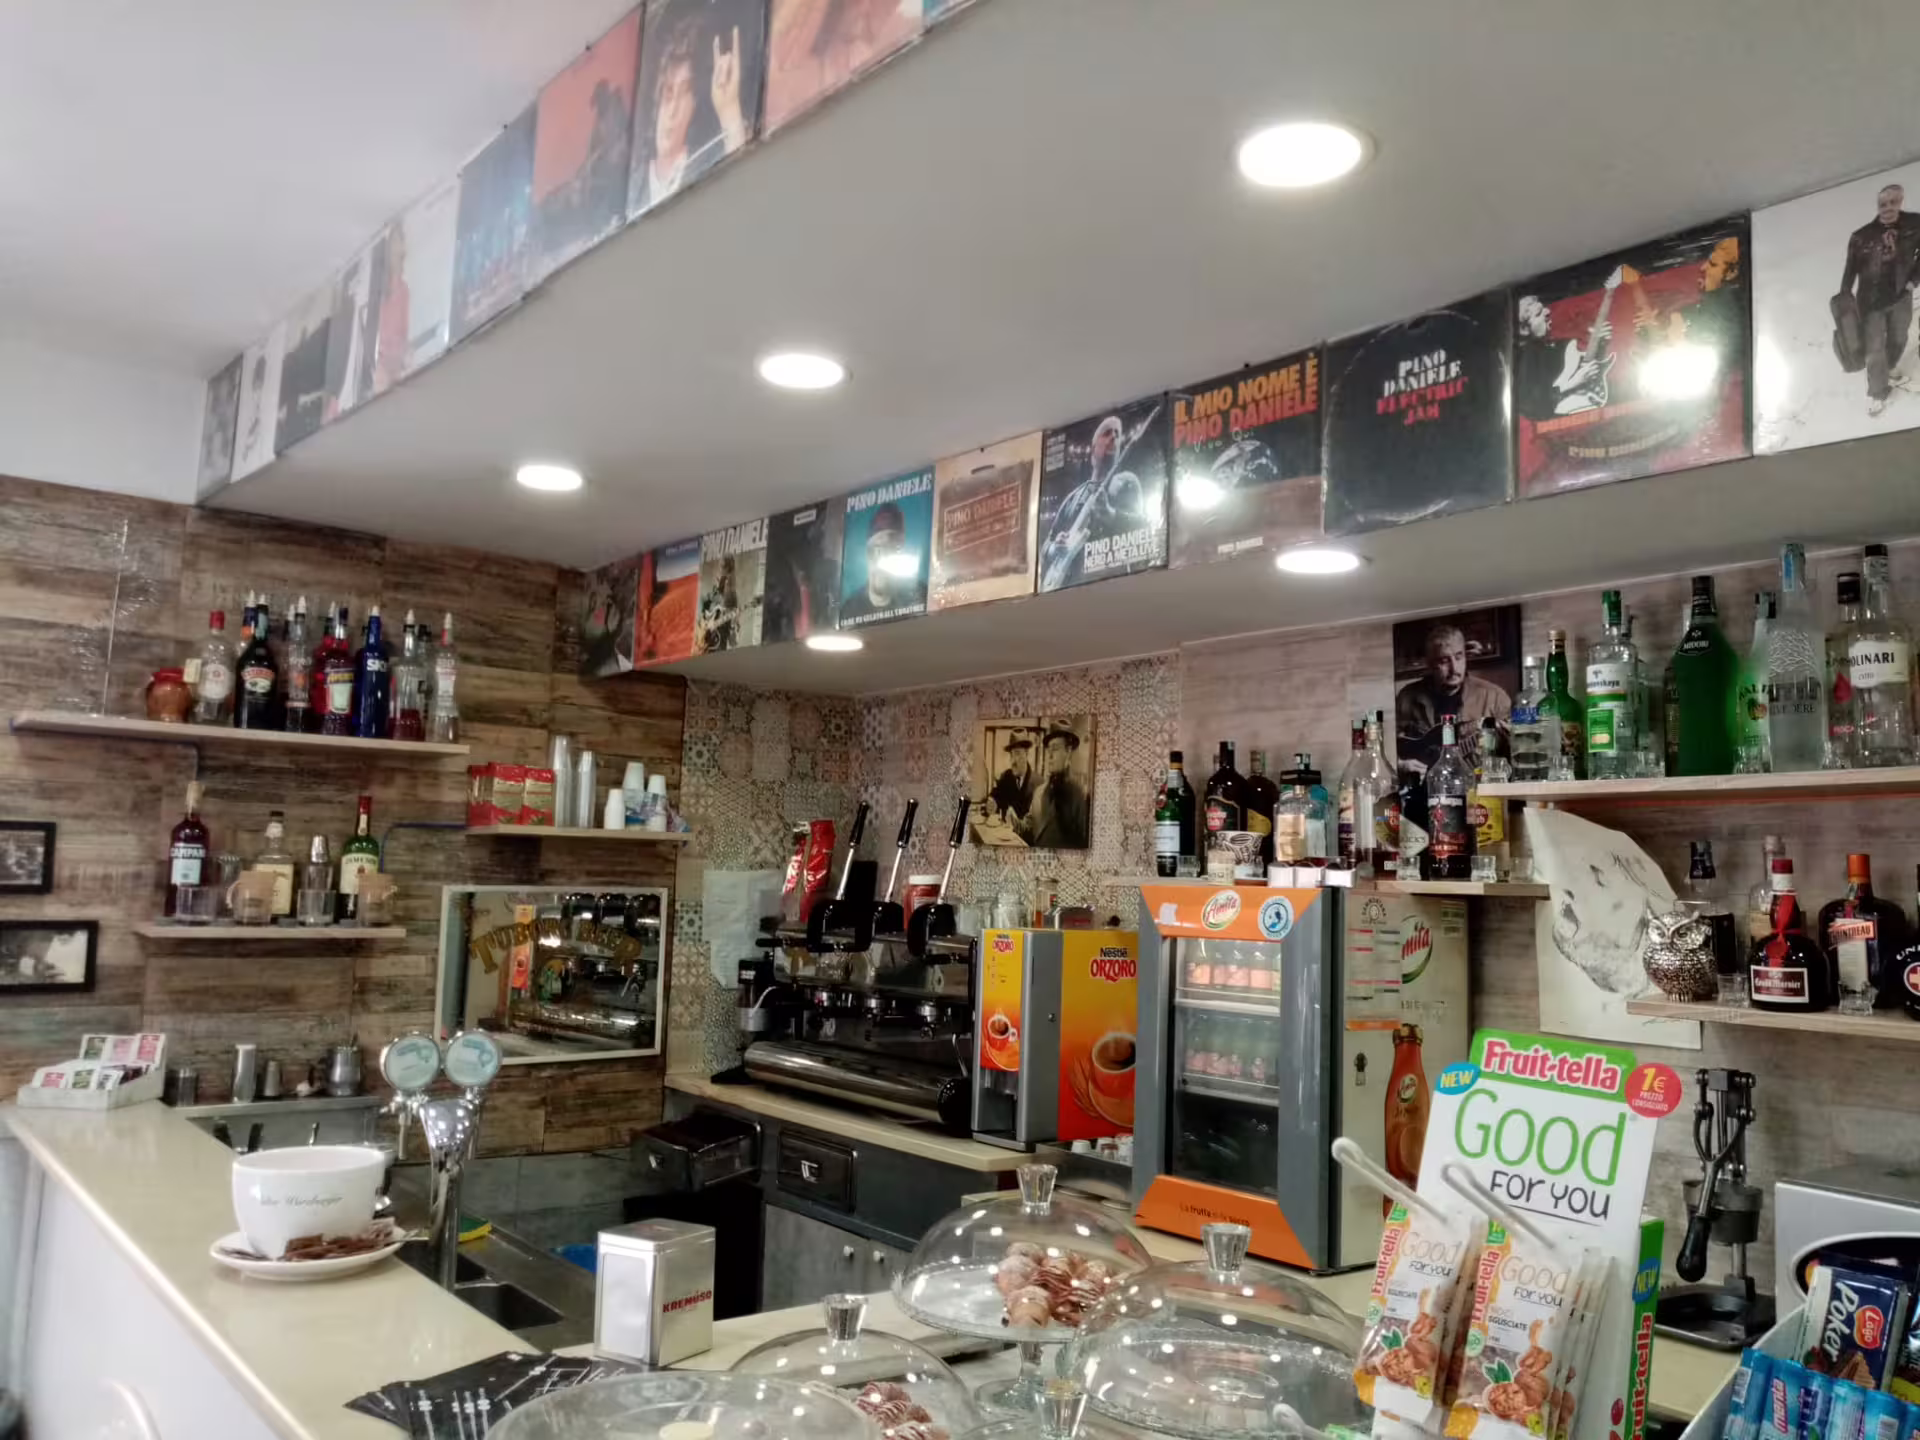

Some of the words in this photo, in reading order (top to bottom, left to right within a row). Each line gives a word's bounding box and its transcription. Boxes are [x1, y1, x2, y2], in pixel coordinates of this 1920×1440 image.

[1384, 360, 1462, 397] DANIELE
[1399, 349, 1446, 376] PINO
[1174, 400, 1188, 424] IL
[1193, 386, 1233, 418] MIO
[1238, 363, 1300, 405] NOME
[1174, 414, 1223, 449] PINO
[1229, 384, 1319, 433] DANIELE
[847, 491, 876, 512] PINO
[878, 474, 932, 504] DANIELE
[702, 530, 725, 562] PINO
[726, 518, 767, 554] DANIELE
[1085, 537, 1110, 556] PINO
[1084, 553, 1106, 569] NERO
[1090, 959, 1136, 982] ORZORO
[1440, 1070, 1474, 1087] NEW
[1484, 1039, 1622, 1092] Fruit-tella
[1371, 1228, 1401, 1297] Fruit-tella
[1471, 1251, 1501, 1322] Fruit-tella
[1822, 1281, 1860, 1362] Poker
[1861, 1305, 1880, 1343] Lago
